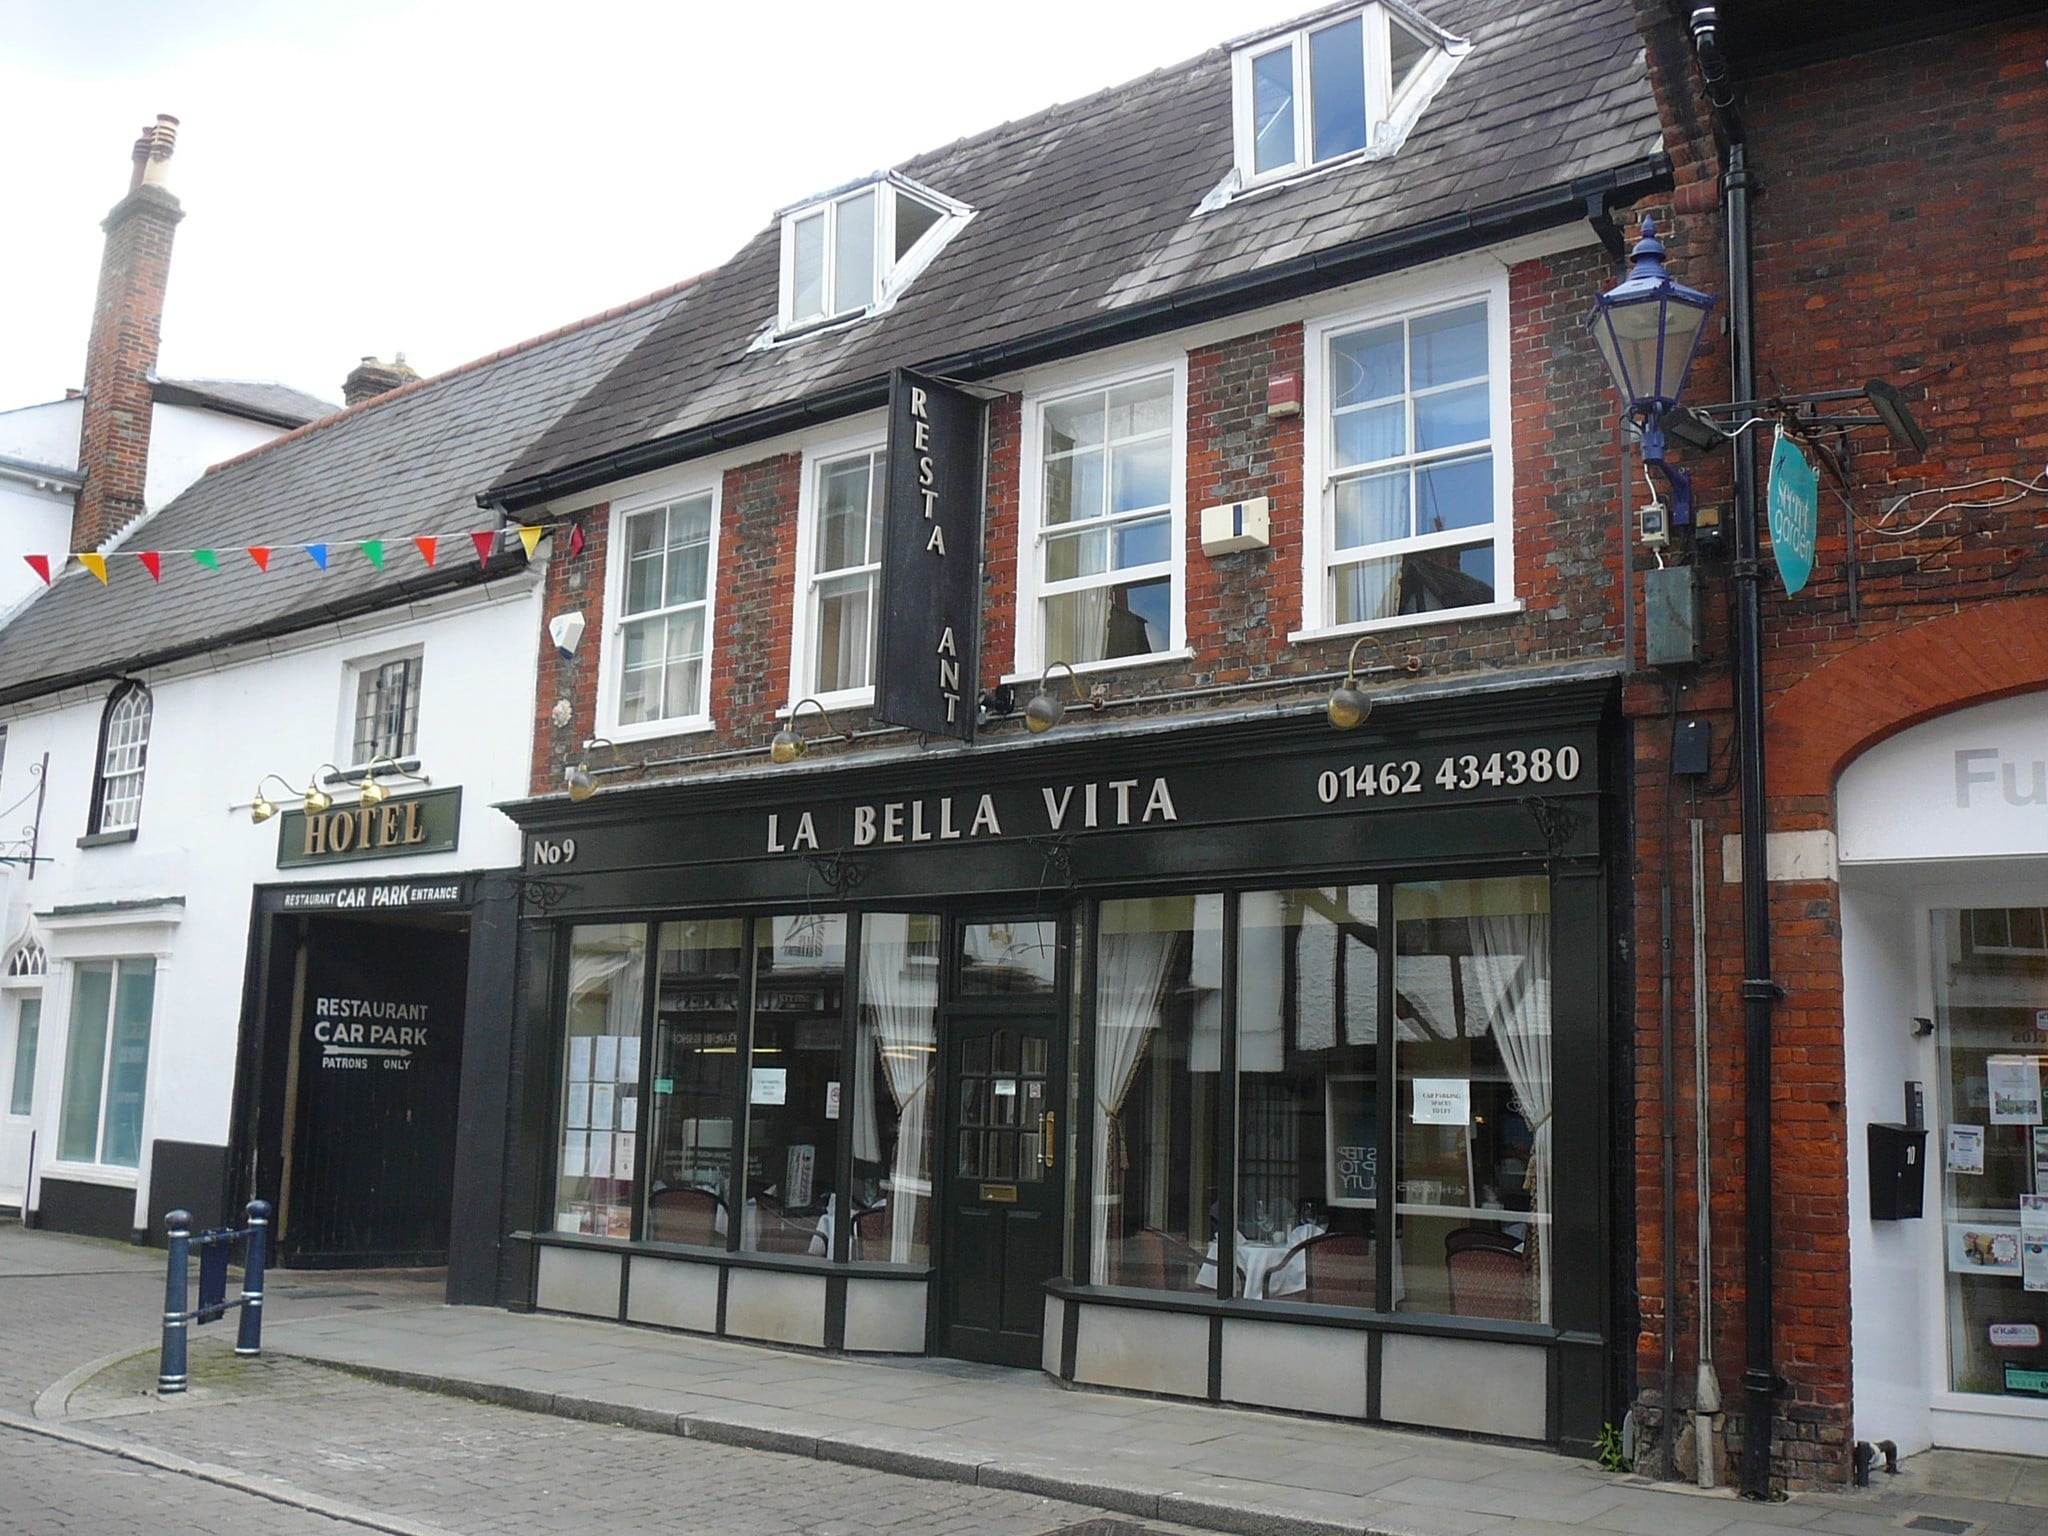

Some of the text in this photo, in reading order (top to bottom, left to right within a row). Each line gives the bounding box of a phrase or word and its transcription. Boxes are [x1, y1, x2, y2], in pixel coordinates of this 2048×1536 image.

[911, 386, 960, 723] RESTA ANT
[1774, 508, 1812, 564] garden
[1317, 745, 1580, 803] 01462 434380
[1954, 747, 2048, 808] Fu
[302, 801, 426, 855] HOTEL
[767, 777, 1178, 853] LA BELLA VITA
[284, 885, 458, 908] RESTAURANT CAR PARK ENTRANCE
[314, 1021, 428, 1046] CAR PARK
[316, 997, 429, 1021] RESTAURANT
[322, 1057, 412, 1070] PATRONS ONLY
